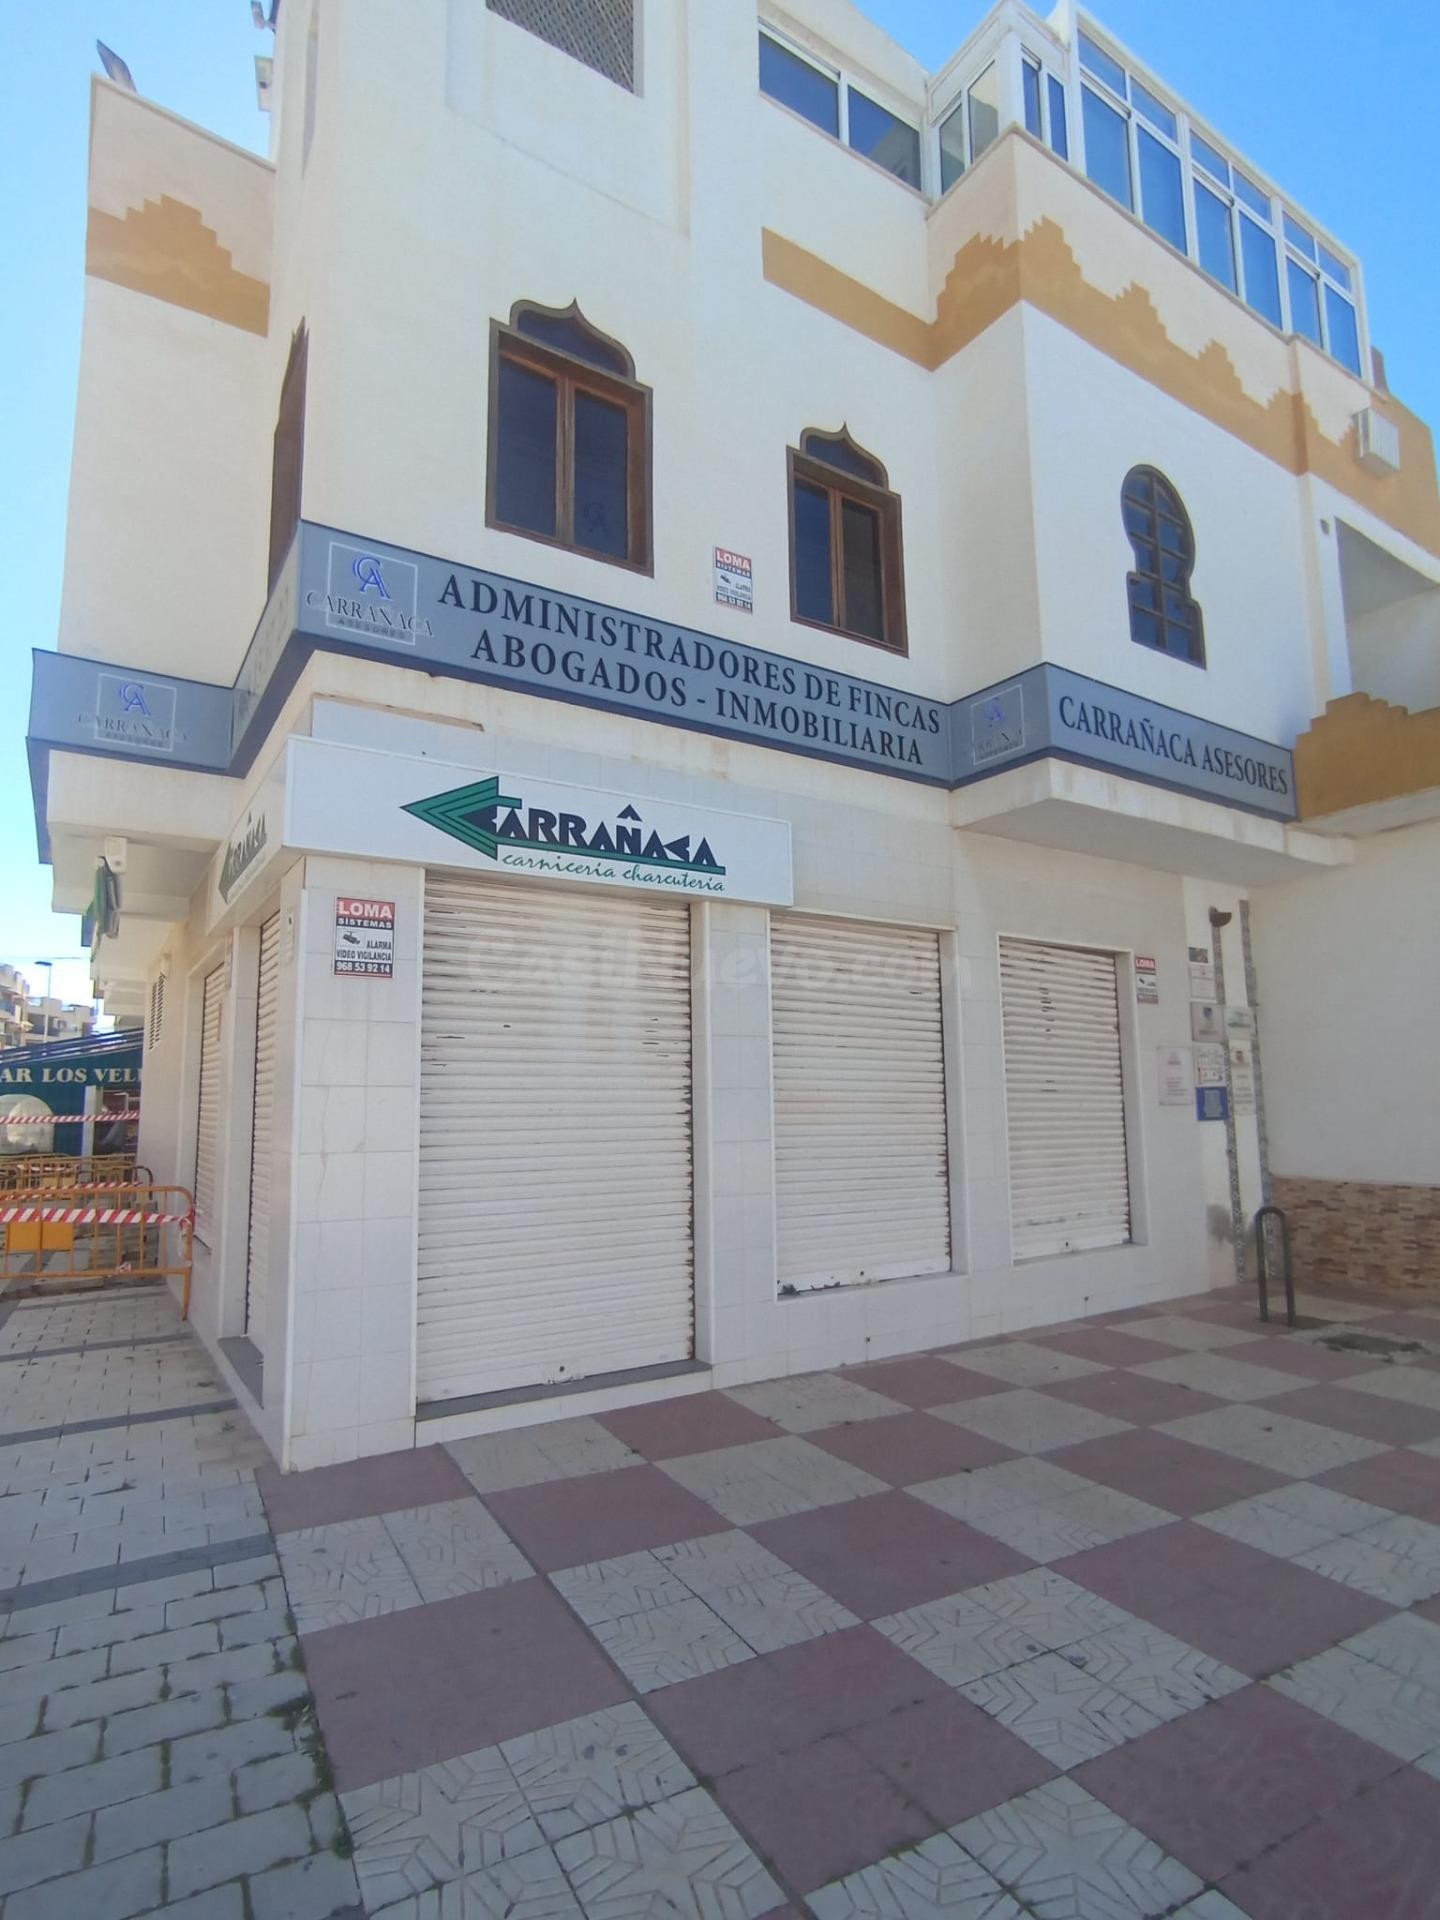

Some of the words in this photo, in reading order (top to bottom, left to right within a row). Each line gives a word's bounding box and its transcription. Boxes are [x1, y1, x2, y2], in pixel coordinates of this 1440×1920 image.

[717, 550, 751, 570] LOMA
[438, 574, 796, 695] ADMINISTRADORES
[804, 673, 841, 709] DE
[847, 685, 940, 735] FINCAS
[470, 630, 687, 707] ABOGADOS
[715, 688, 924, 766] INMOBILIARIA
[1059, 696, 1196, 768] CARRAÑACA
[1200, 744, 1288, 795] ASESORES
[339, 901, 393, 919] LOMA
[338, 917, 393, 929] SISTEMAS
[366, 939, 392, 950] ALARMA
[336, 949, 356, 959] VIDEO
[357, 950, 392, 961] VIGILANCIA
[336, 961, 353, 971] 968
[354, 962, 366, 972] 53
[367, 963, 378, 973] 92
[380, 964, 390, 973] 14
[42, 1067, 88, 1083] LOS
